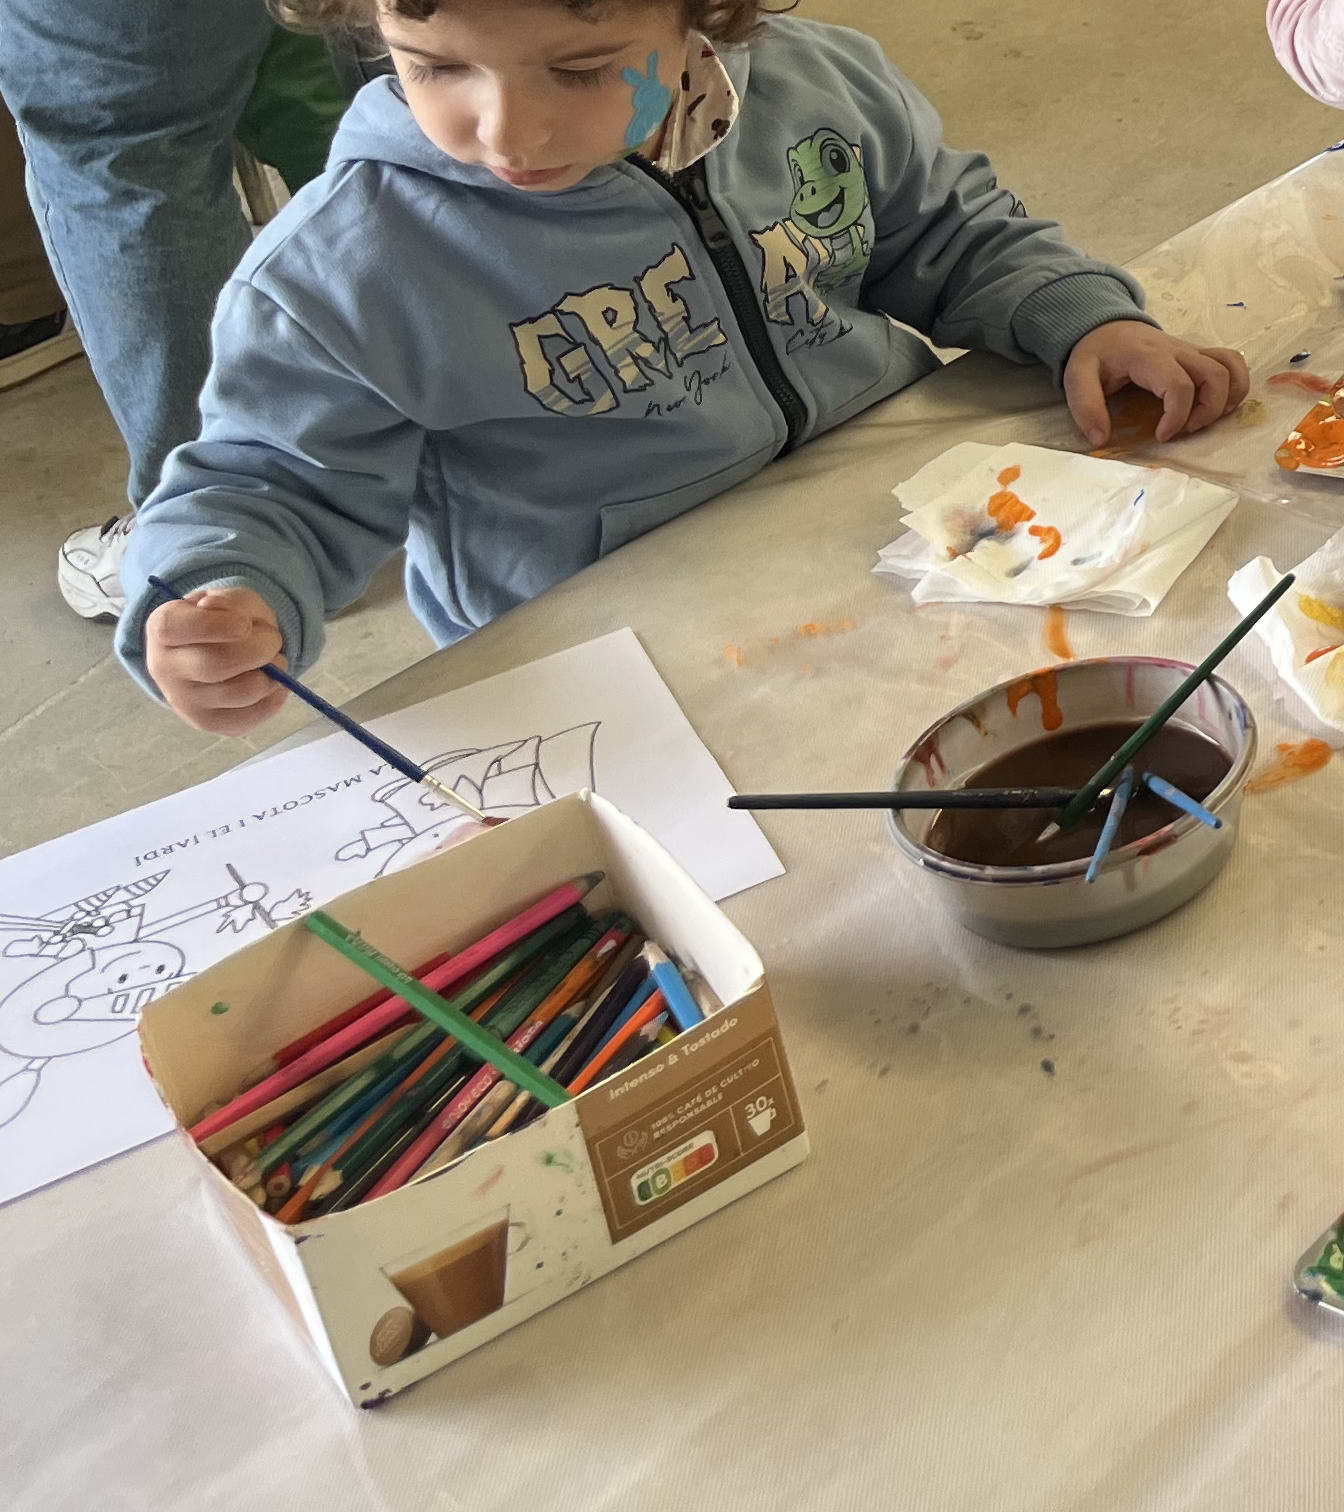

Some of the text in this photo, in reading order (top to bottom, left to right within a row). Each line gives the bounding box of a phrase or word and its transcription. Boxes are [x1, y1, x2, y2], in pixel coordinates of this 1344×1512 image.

[250, 773, 363, 822] MASCOTA
[210, 823, 232, 838] EL
[608, 1016, 739, 1102] Intenso & Tostado
[676, 1094, 704, 1115] CAFÉ
[704, 1085, 719, 1098] DE
[719, 1057, 761, 1088] CULTIVO
[652, 1091, 724, 1139] RESPONSABLE
